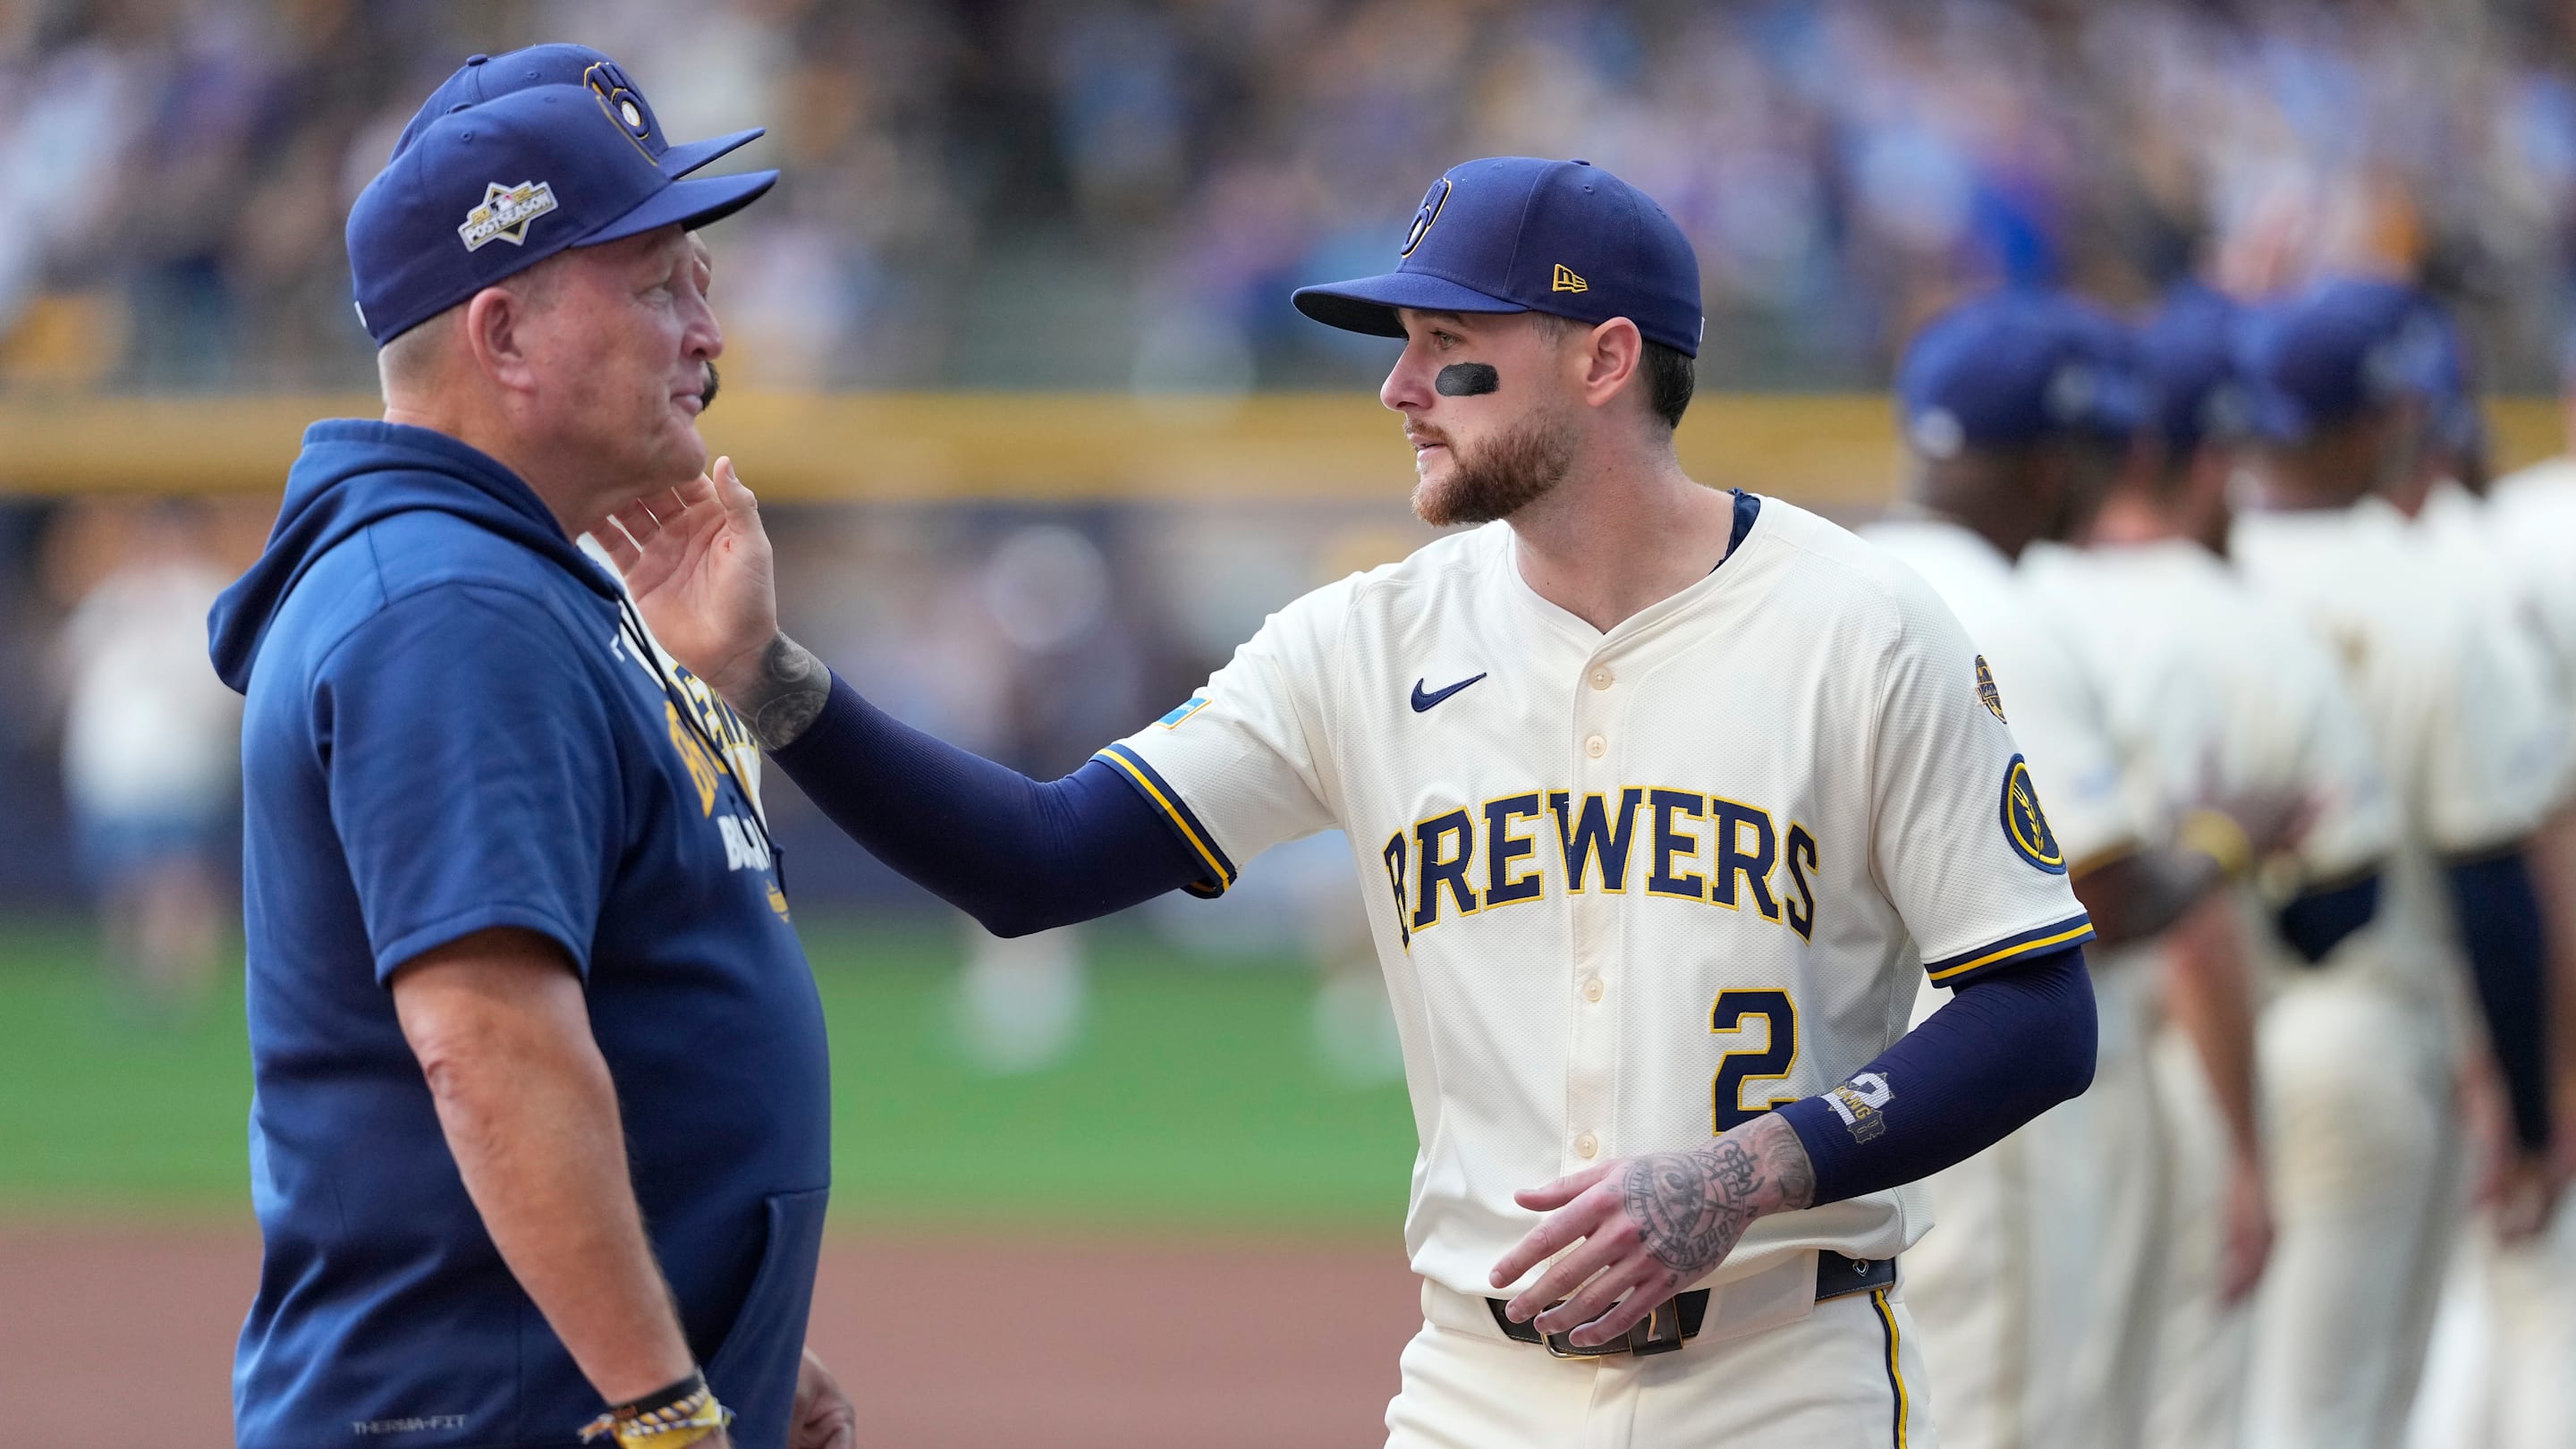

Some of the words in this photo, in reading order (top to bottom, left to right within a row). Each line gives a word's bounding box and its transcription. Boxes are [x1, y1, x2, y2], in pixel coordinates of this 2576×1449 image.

[462, 191, 554, 244] POSTSEASON
[1383, 785, 1819, 955] BREWERS
[1710, 987, 1800, 1136] 2
[1833, 1085, 1873, 1122] RANG
[352, 1413, 468, 1436] THERMA-FIT
